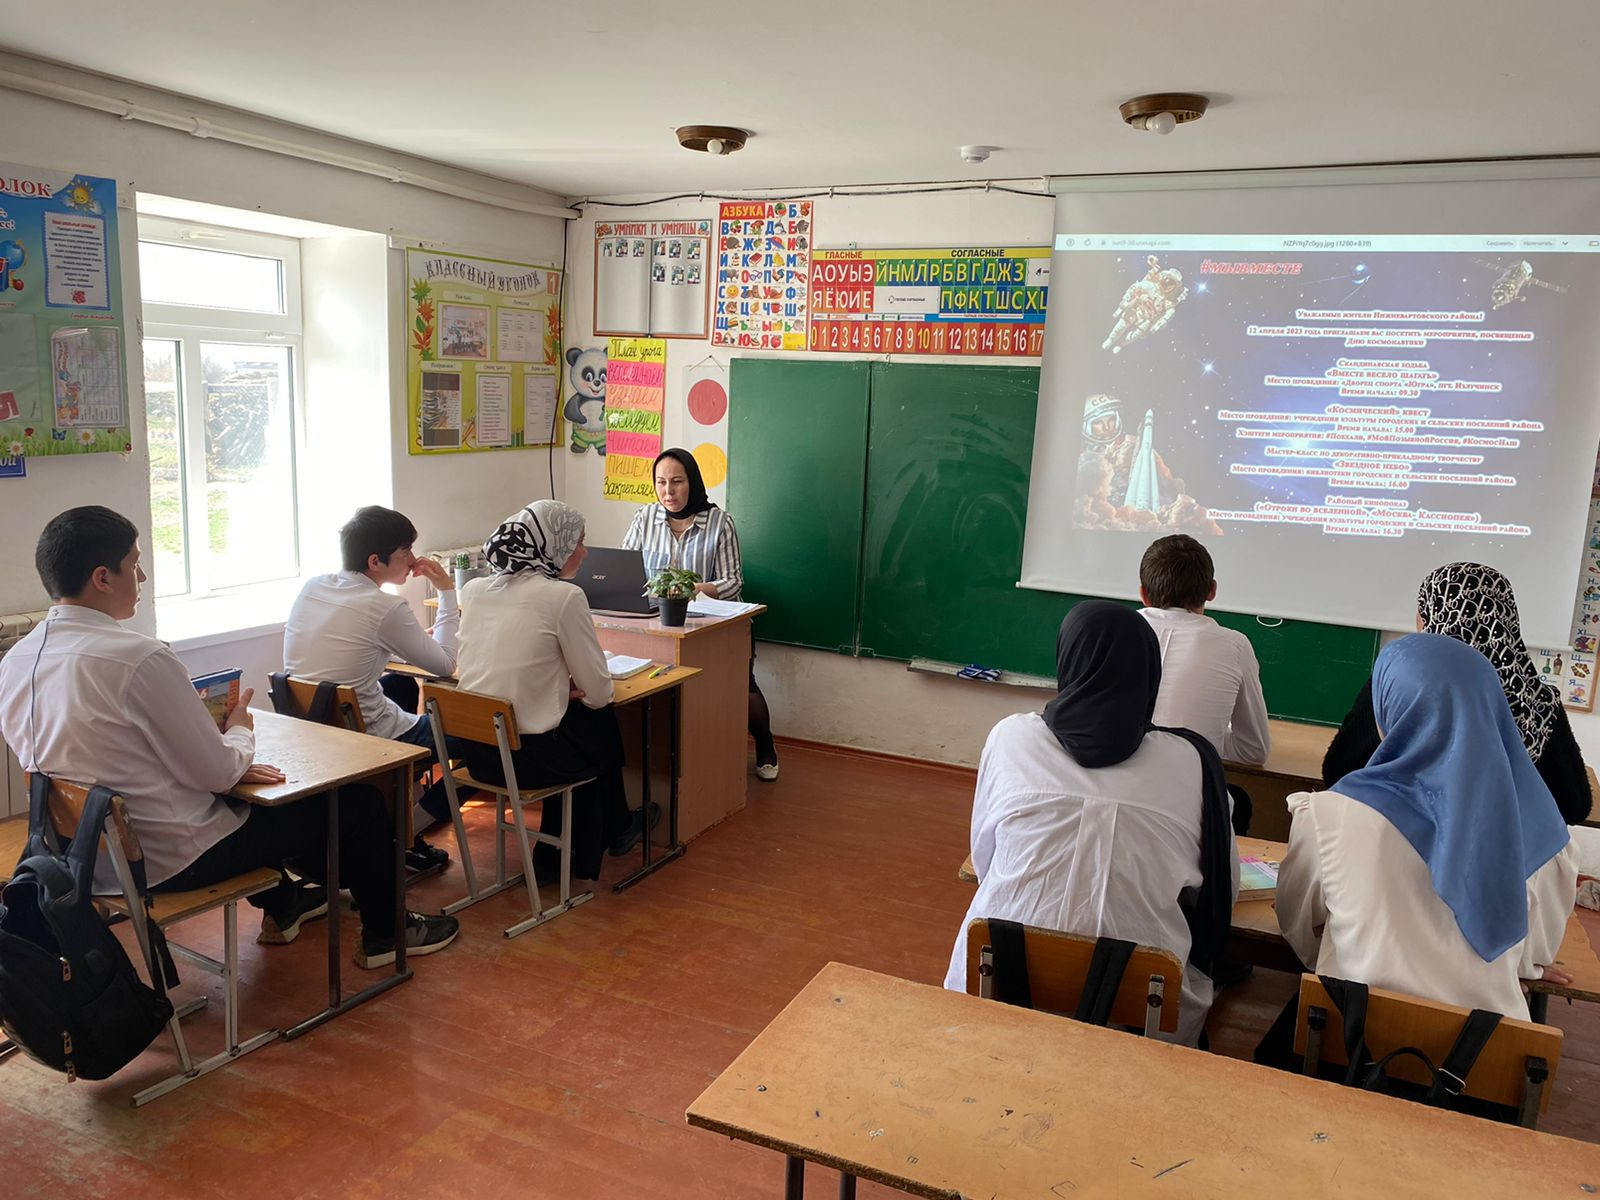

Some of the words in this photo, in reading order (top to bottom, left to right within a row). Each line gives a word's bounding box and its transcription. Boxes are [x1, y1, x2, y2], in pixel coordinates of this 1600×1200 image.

[722, 206, 763, 217] АЗБУКА
[766, 205, 775, 218] А
[788, 204, 797, 218] Б
[614, 224, 647, 235] УМНИКИ
[651, 224, 657, 235] И
[661, 223, 696, 235] УМНИЦЫ
[722, 222, 729, 235] В
[744, 222, 751, 235] Г
[765, 221, 775, 235] Д
[788, 221, 796, 234] Е
[721, 236, 728, 251] Ё
[743, 238, 754, 251] Ж
[765, 238, 772, 251] З
[787, 238, 796, 251] И
[720, 252, 728, 267] Й
[742, 254, 750, 267] К
[764, 254, 773, 267] Л
[787, 254, 797, 267] М
[825, 251, 862, 259] ГЛАСНЫЕ
[951, 249, 1005, 258] СОГЛАСНЫЕ
[1200, 259, 1302, 275] #МЫВМЕСТЕ
[425, 259, 495, 289] КЛАССНЫЙ
[498, 270, 541, 292] УГОЛОК
[720, 270, 728, 283] Н
[741, 270, 750, 283] О
[764, 270, 771, 283] П
[786, 271, 794, 283] Р
[719, 286, 725, 299] С
[763, 286, 771, 299] У
[786, 287, 796, 300] Ф
[717, 302, 725, 314] Х
[741, 302, 749, 316] Ц
[763, 303, 770, 315] Ч
[785, 303, 796, 316] Ш
[716, 317, 728, 331] Щ
[740, 320, 748, 331] Ъ
[762, 321, 772, 331] Ы
[784, 322, 791, 332] Ь
[738, 334, 750, 346] Ю
[761, 335, 769, 348] Я
[811, 326, 817, 346] 0
[821, 327, 827, 346] 1
[831, 327, 838, 347] 2
[842, 327, 849, 347] 3
[852, 328, 859, 347] 4
[863, 327, 870, 347] 5
[874, 327, 881, 348] 6
[885, 328, 892, 348] 7
[896, 328, 903, 348] 8
[906, 328, 914, 349] 9
[917, 328, 930, 349] 10
[933, 328, 944, 349] 11
[948, 328, 961, 349] 12
[965, 329, 978, 350] 13
[980, 329, 993, 350] 14
[997, 329, 1010, 351] 15
[1013, 329, 1027, 351] 16
[1030, 329, 1044, 352] 17
[611, 338, 638, 358] План
[640, 347, 662, 362] урока
